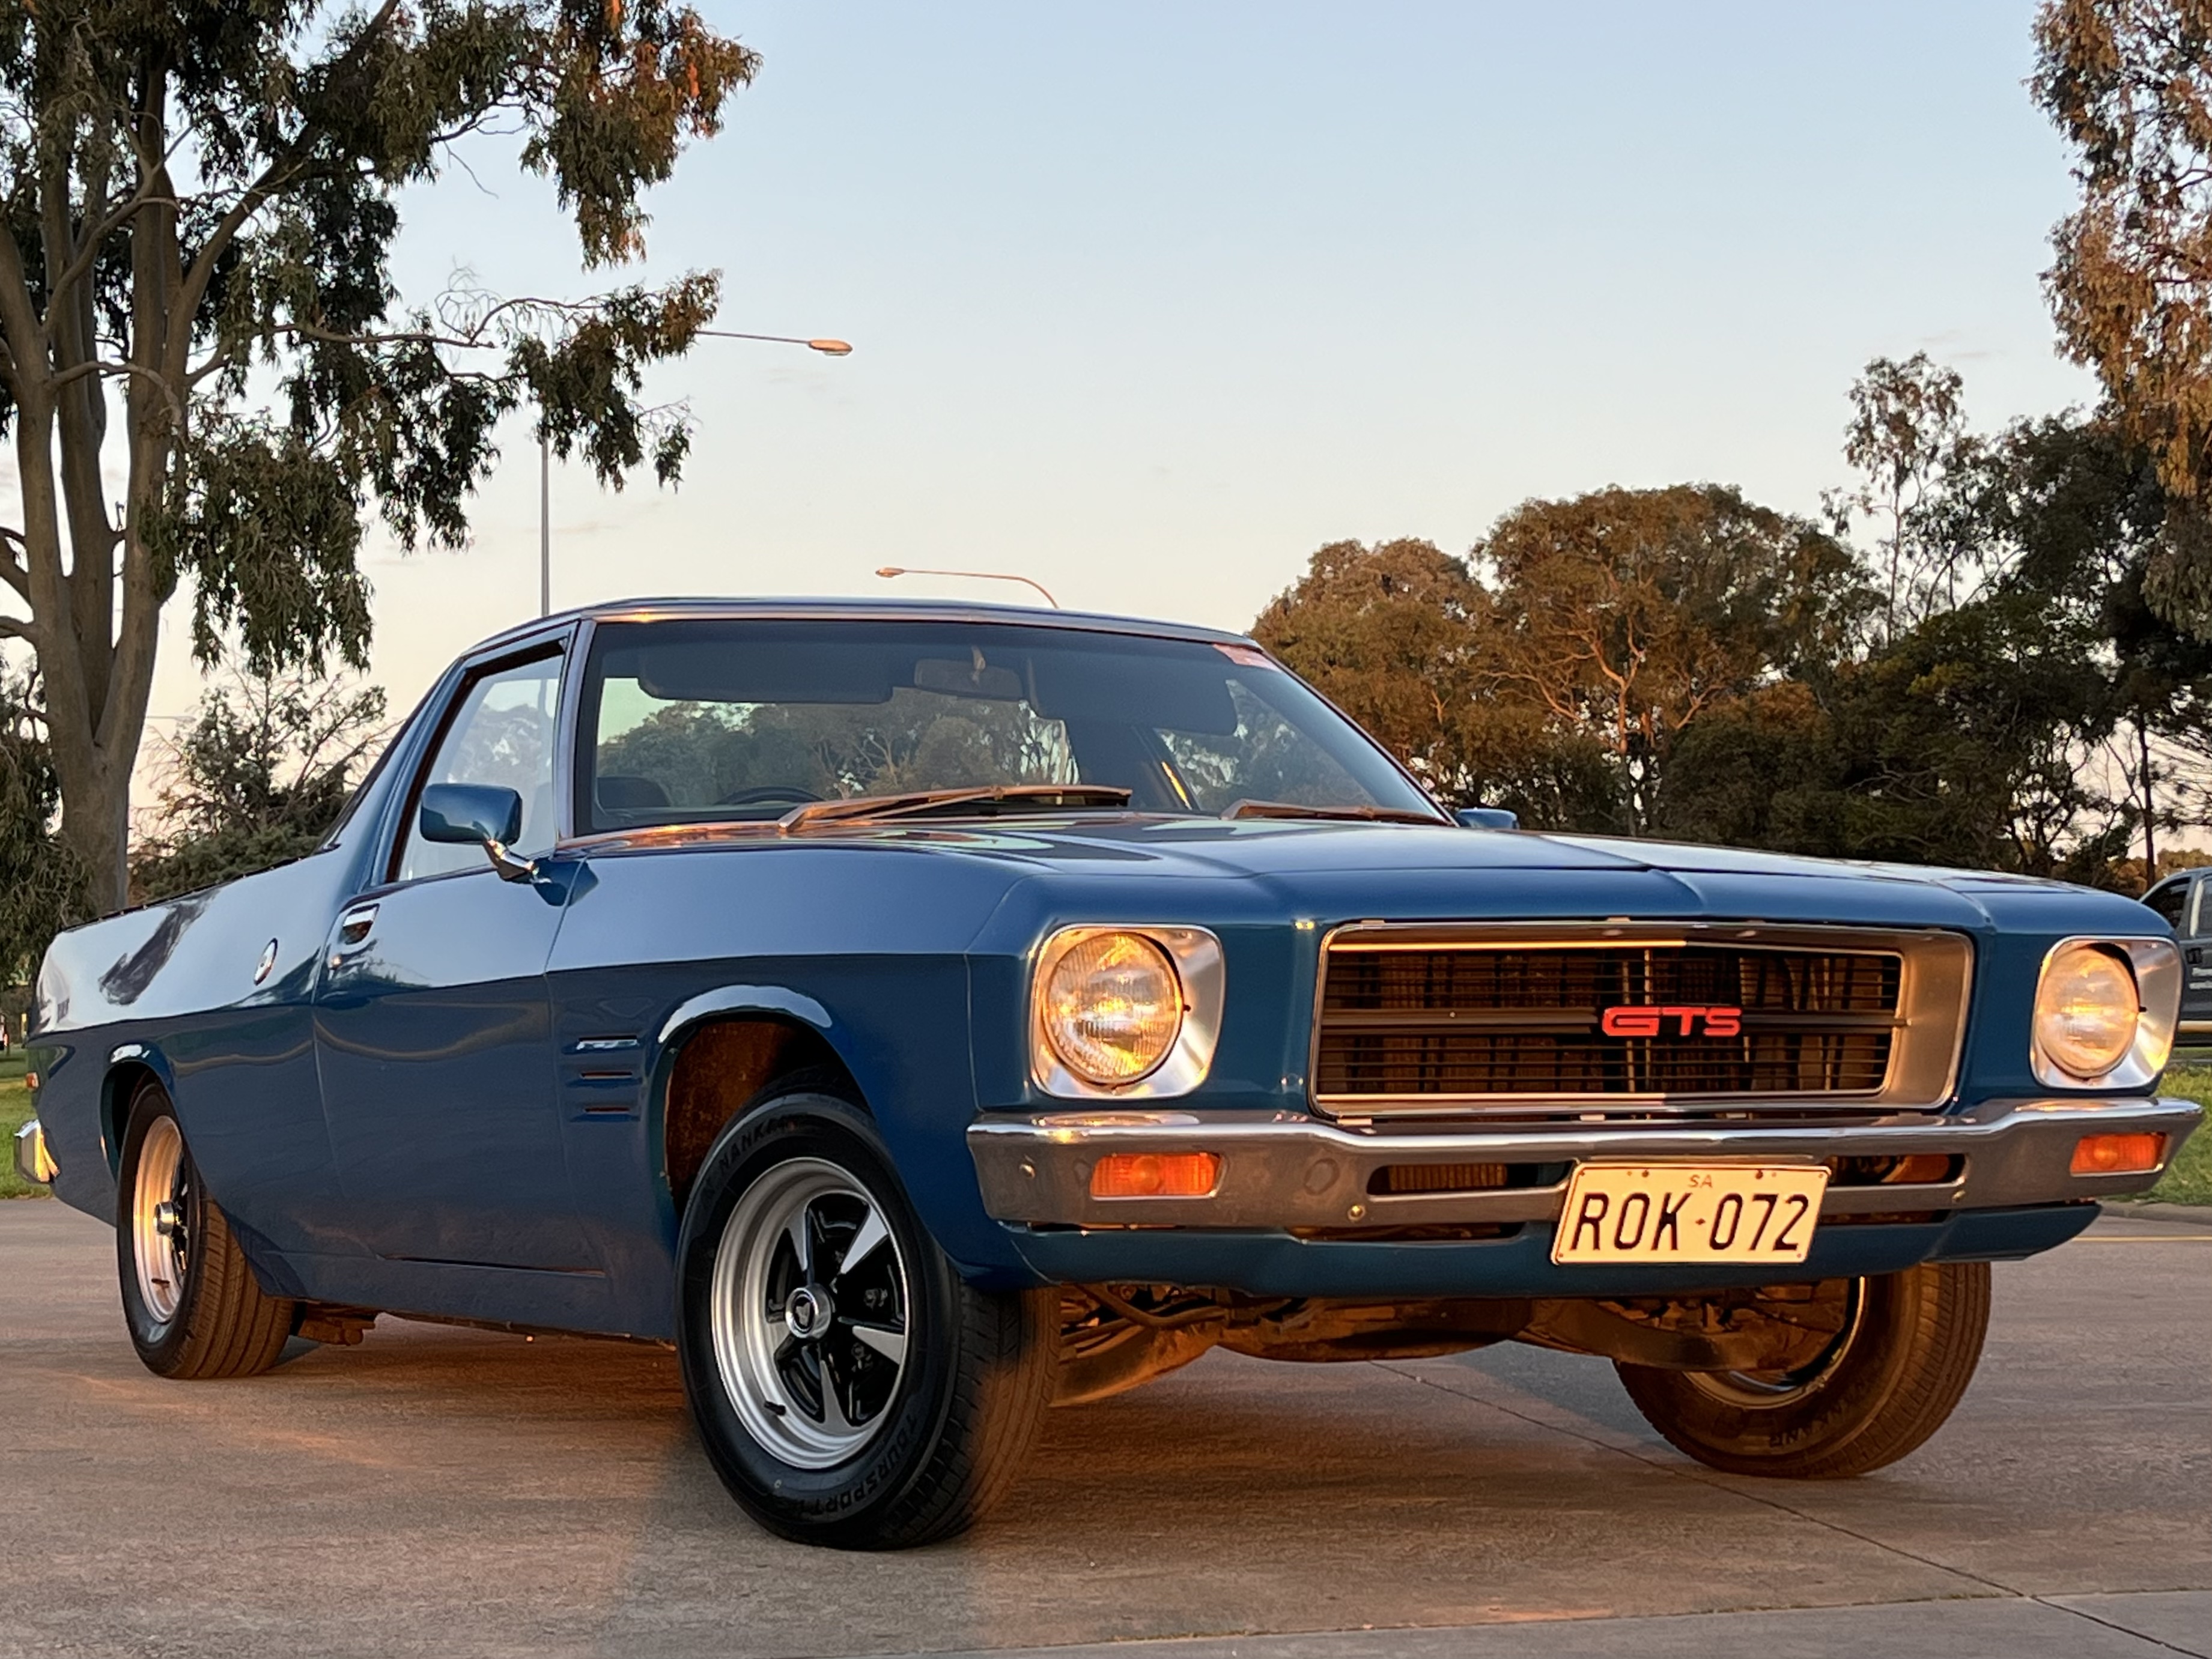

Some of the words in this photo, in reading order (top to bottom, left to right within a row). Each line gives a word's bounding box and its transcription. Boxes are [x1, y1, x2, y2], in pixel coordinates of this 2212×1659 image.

[1602, 1006, 1741, 1036] GTS
[1688, 1174, 1713, 1189] SA
[1569, 1192, 1692, 1251] ROK
[1709, 1192, 1809, 1251] 072
